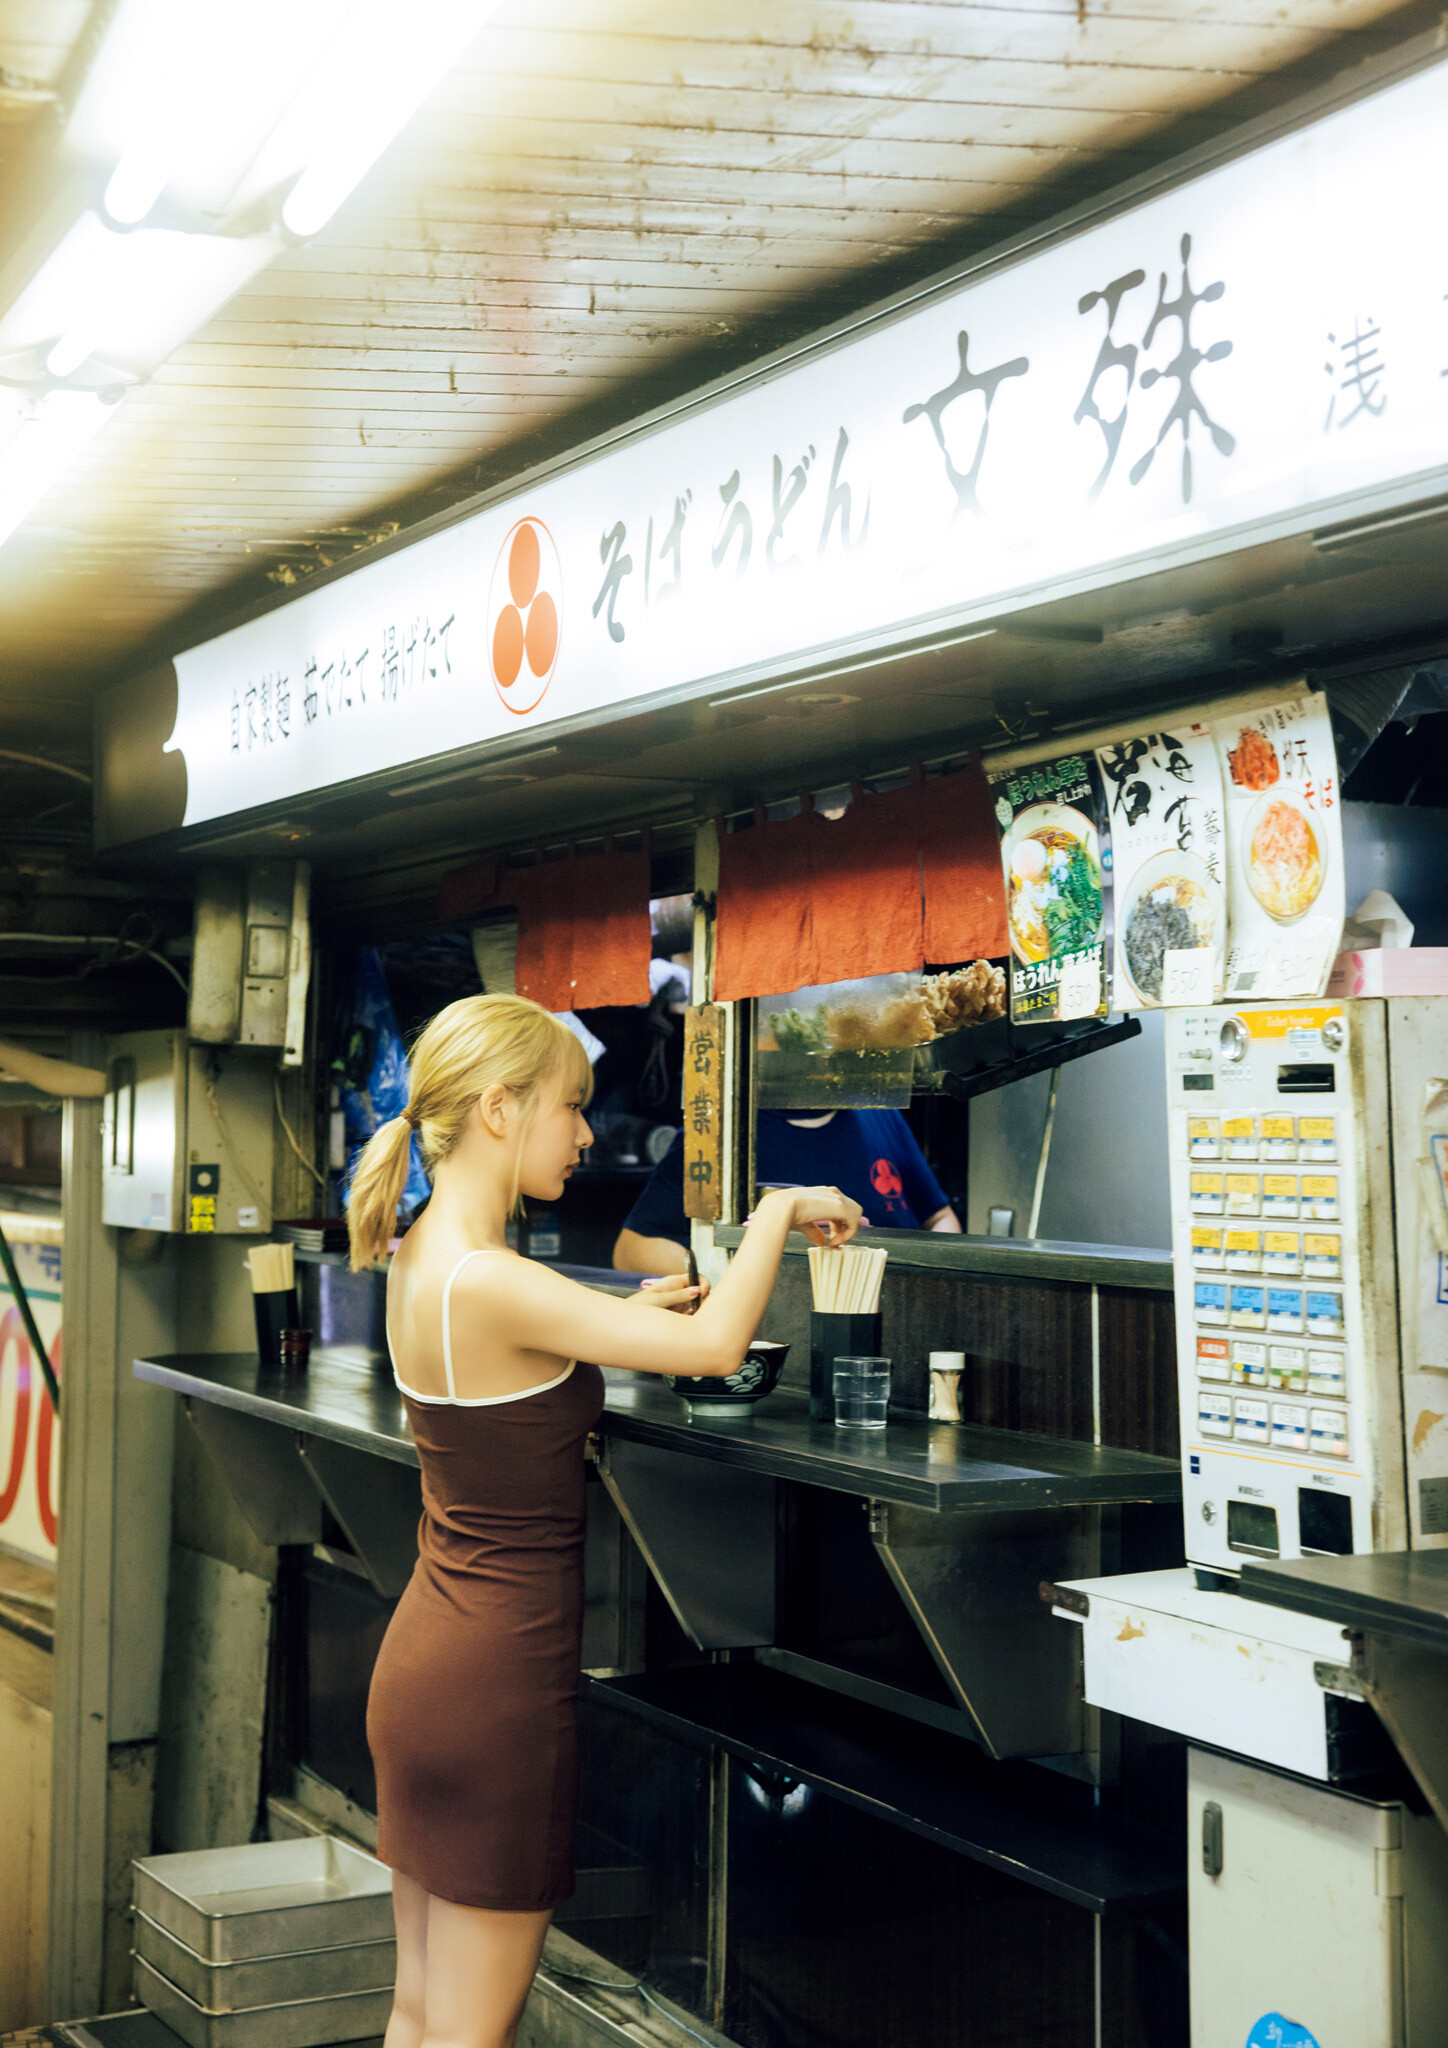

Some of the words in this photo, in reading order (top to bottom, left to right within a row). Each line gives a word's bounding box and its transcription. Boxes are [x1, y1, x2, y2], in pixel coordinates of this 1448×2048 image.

[902, 232, 1236, 524] 文殊
[689, 1029, 714, 1195] 営業中
